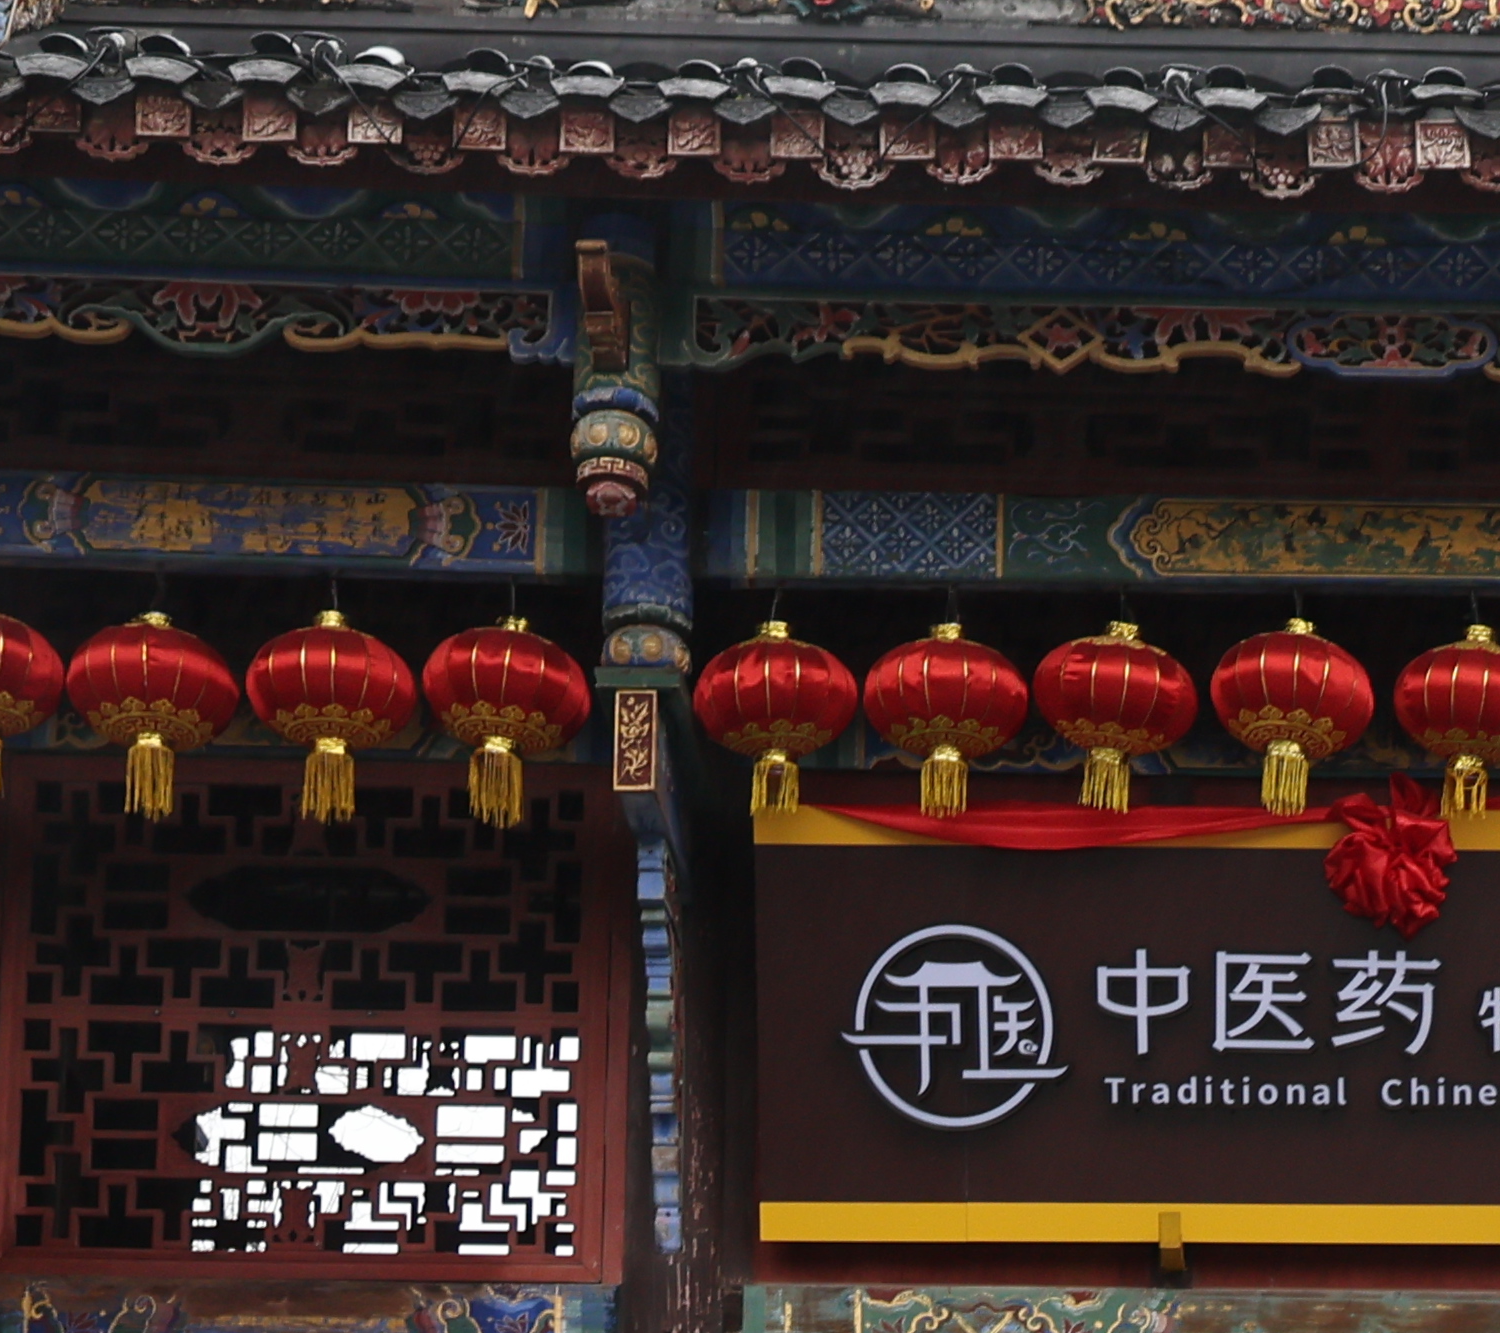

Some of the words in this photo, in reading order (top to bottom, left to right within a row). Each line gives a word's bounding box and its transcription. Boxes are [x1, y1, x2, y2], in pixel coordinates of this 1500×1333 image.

[1096, 948, 1443, 1056] 中医药
[1104, 1076, 1348, 1108] Traditional
